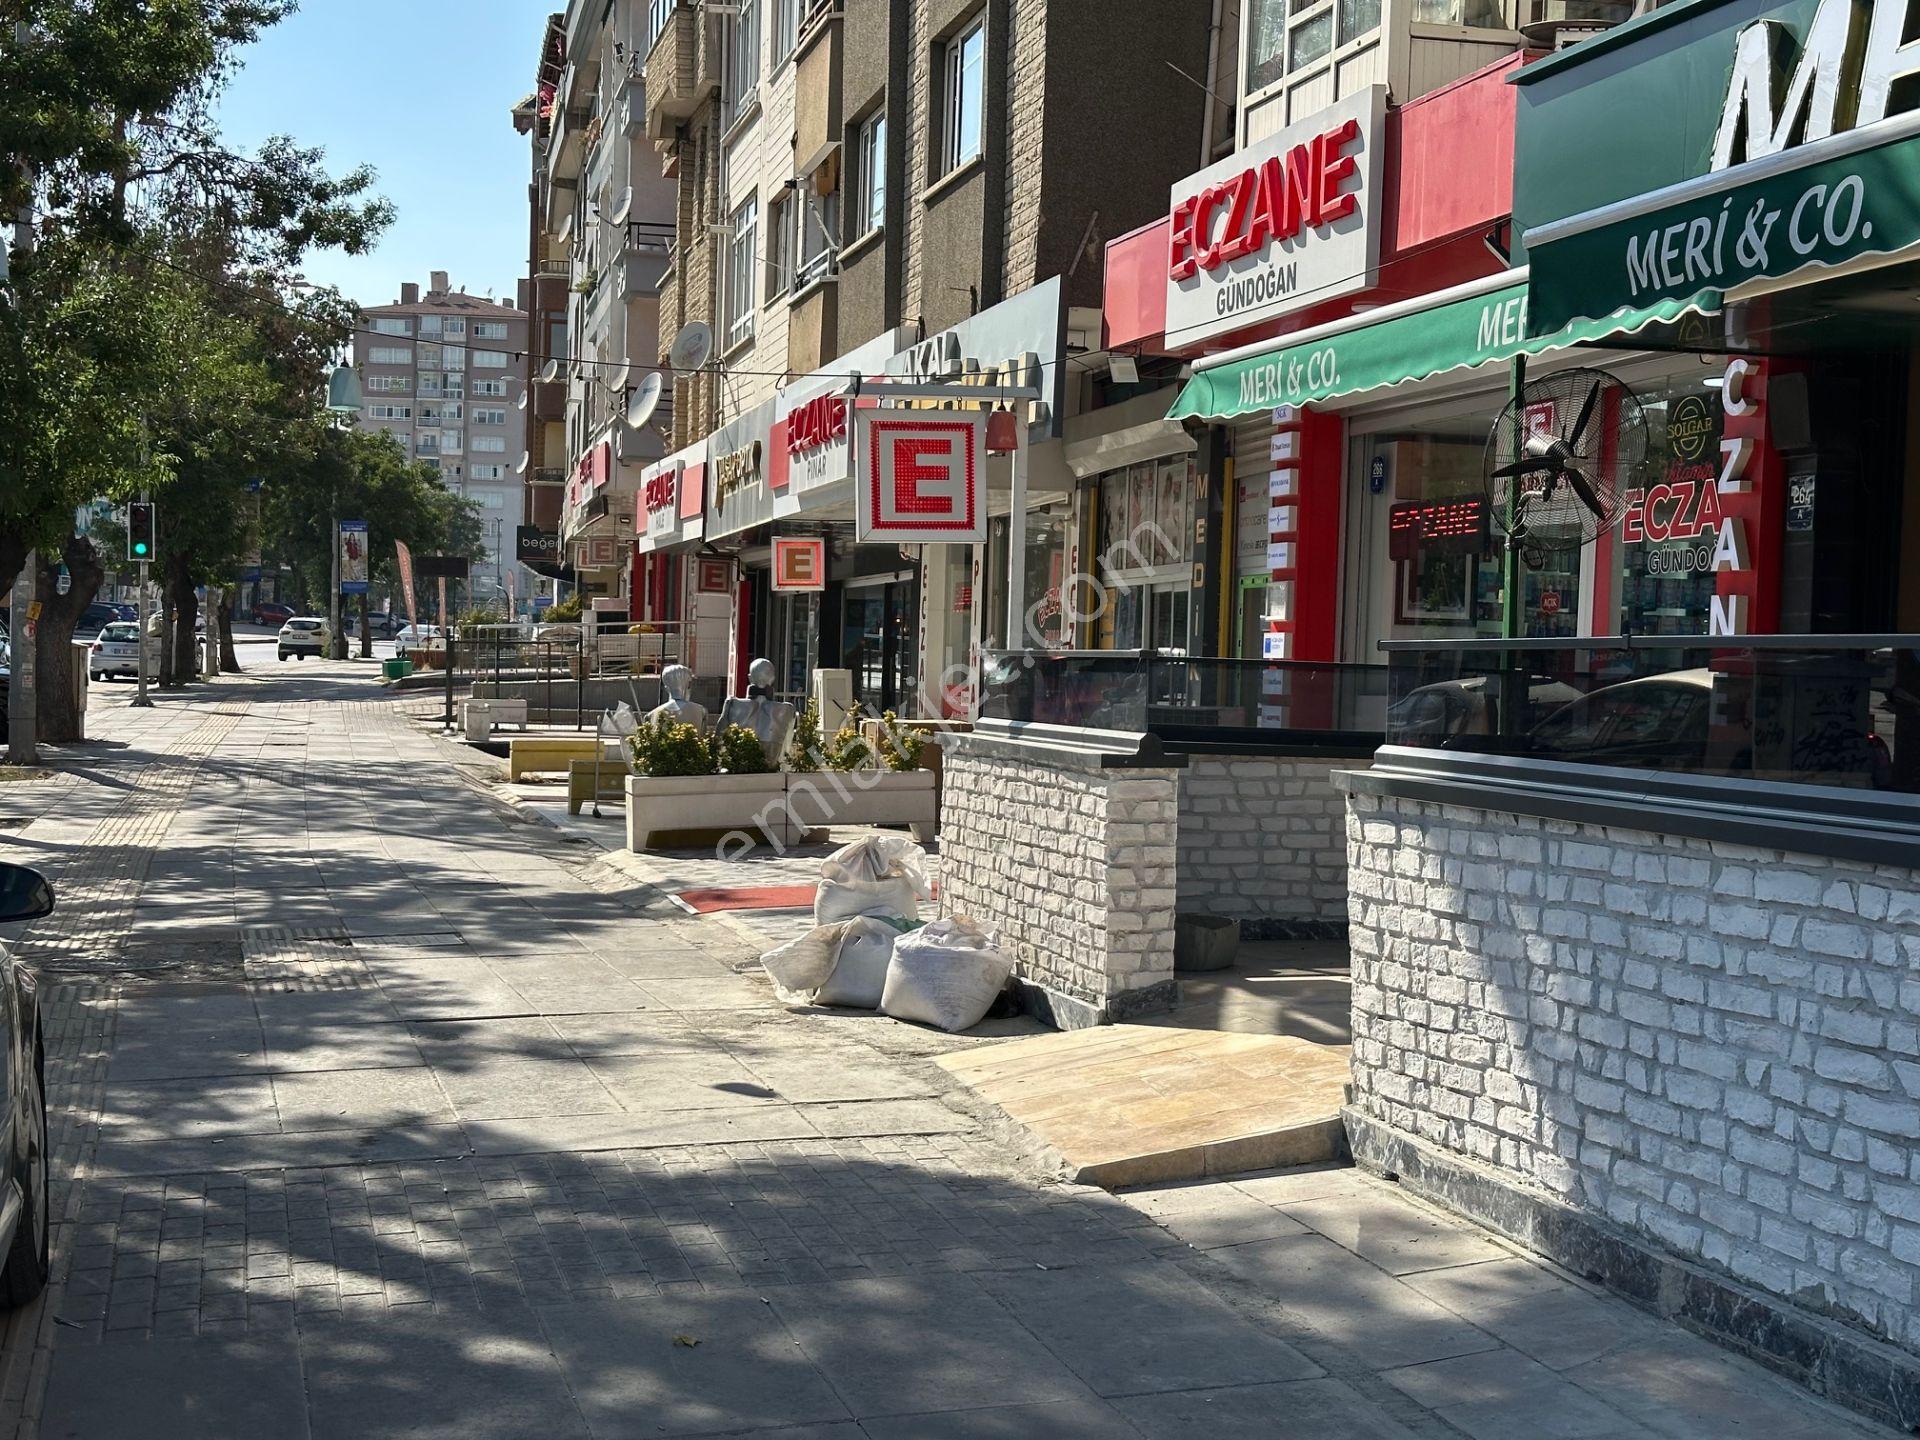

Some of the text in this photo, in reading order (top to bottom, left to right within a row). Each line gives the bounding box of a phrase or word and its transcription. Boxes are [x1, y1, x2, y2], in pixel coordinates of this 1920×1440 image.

[1170, 118, 1357, 281] ECZANE
[1626, 175, 1872, 295] MERİ & CO.
[1216, 262, 1297, 315] GÜNDOĞAN
[1238, 348, 1341, 407] MERİ & CO.
[788, 390, 847, 455] ECZANE
[1667, 416, 1713, 439] SOLGAR
[894, 438, 953, 514] E
[786, 548, 811, 579] E
